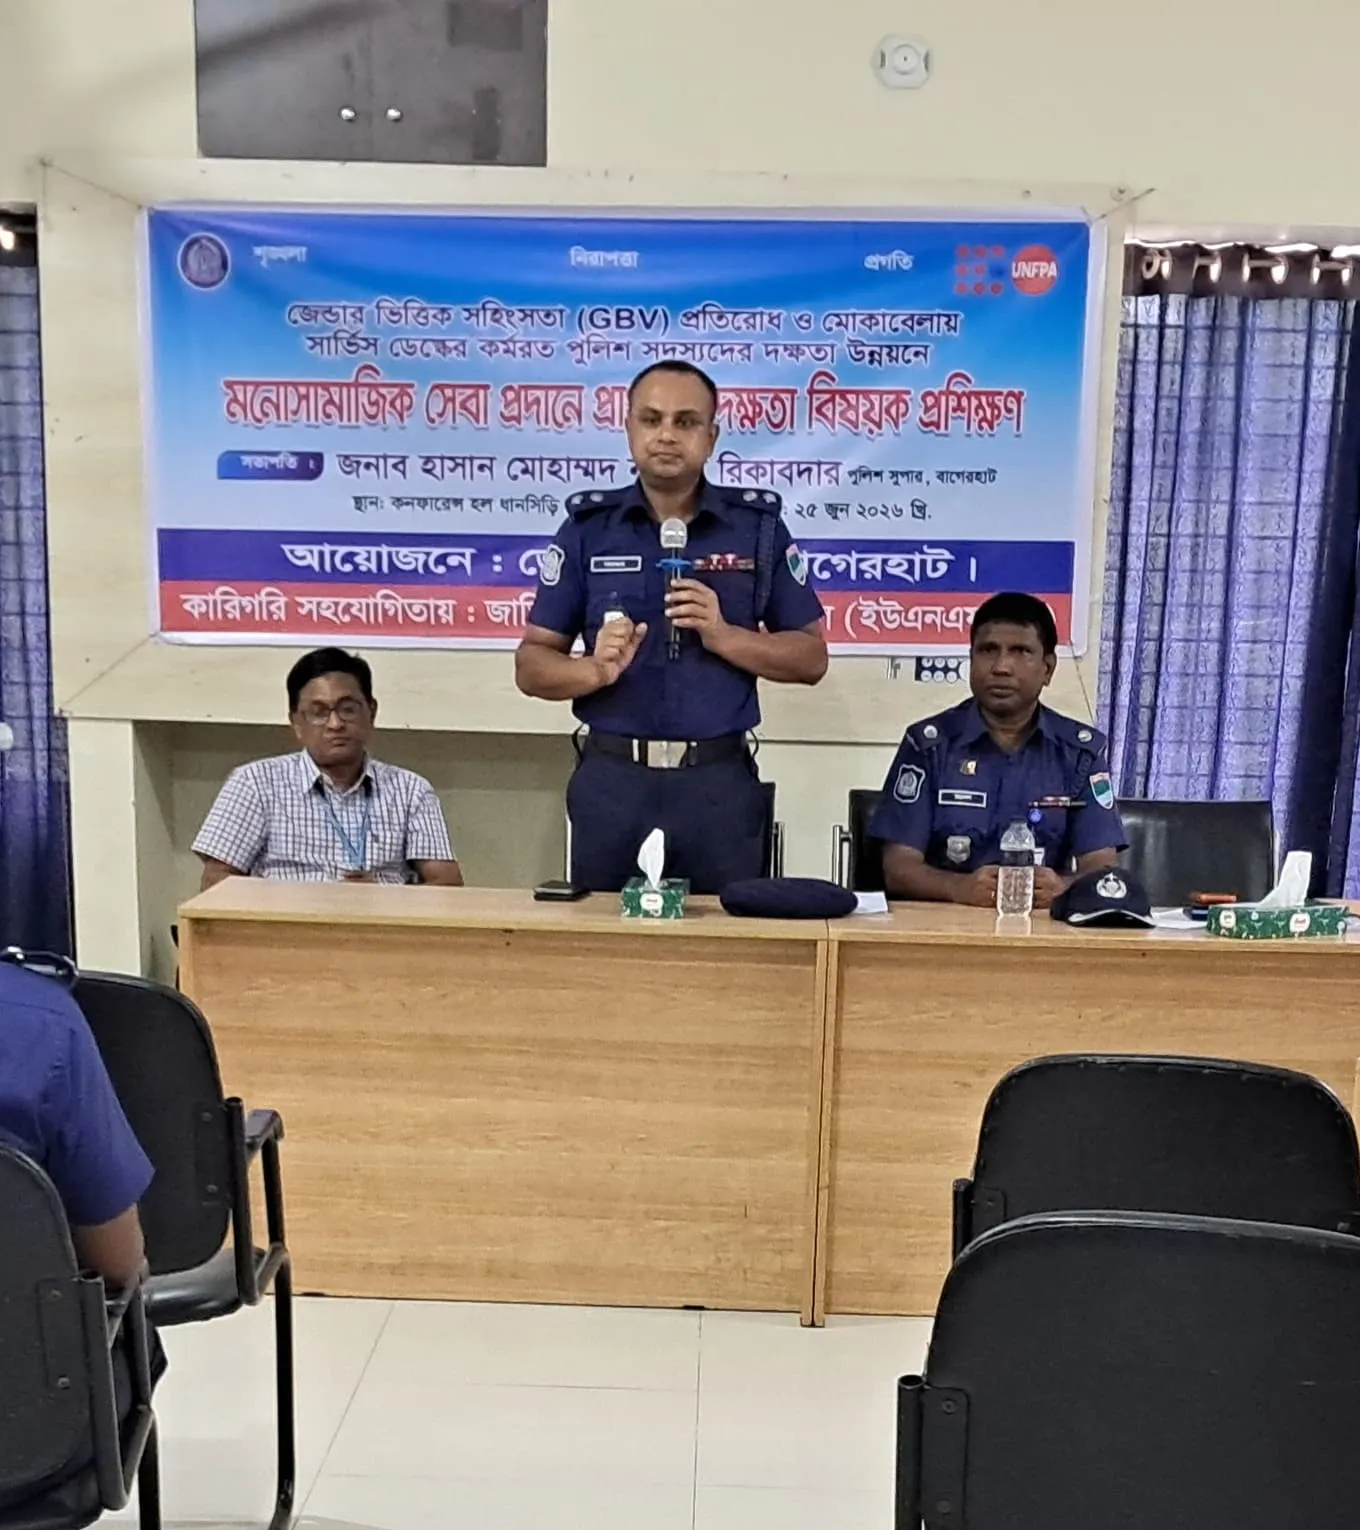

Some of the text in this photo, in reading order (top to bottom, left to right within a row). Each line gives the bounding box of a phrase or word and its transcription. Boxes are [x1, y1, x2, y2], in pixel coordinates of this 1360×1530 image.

[1011, 261, 1058, 279] UNFPA
[462, 299, 566, 329] সহিংসতা
[577, 307, 670, 335] (GBV)
[680, 302, 783, 333] প্রতিরোধ
[795, 310, 813, 331] ও
[566, 334, 633, 367] পুলিশ
[763, 341, 838, 364] দক্ষতা
[223, 366, 415, 428] মনোসামাজিক
[424, 383, 492, 428] সেবা
[500, 384, 585, 430] প্রদানে
[336, 454, 409, 480] জনাব
[418, 454, 497, 481] হাসান
[717, 452, 842, 487] রিকাবদার
[281, 543, 477, 577] আয়োজনে
[796, 545, 956, 584] াগেরহাট
[180, 585, 289, 623] কারিগরি
